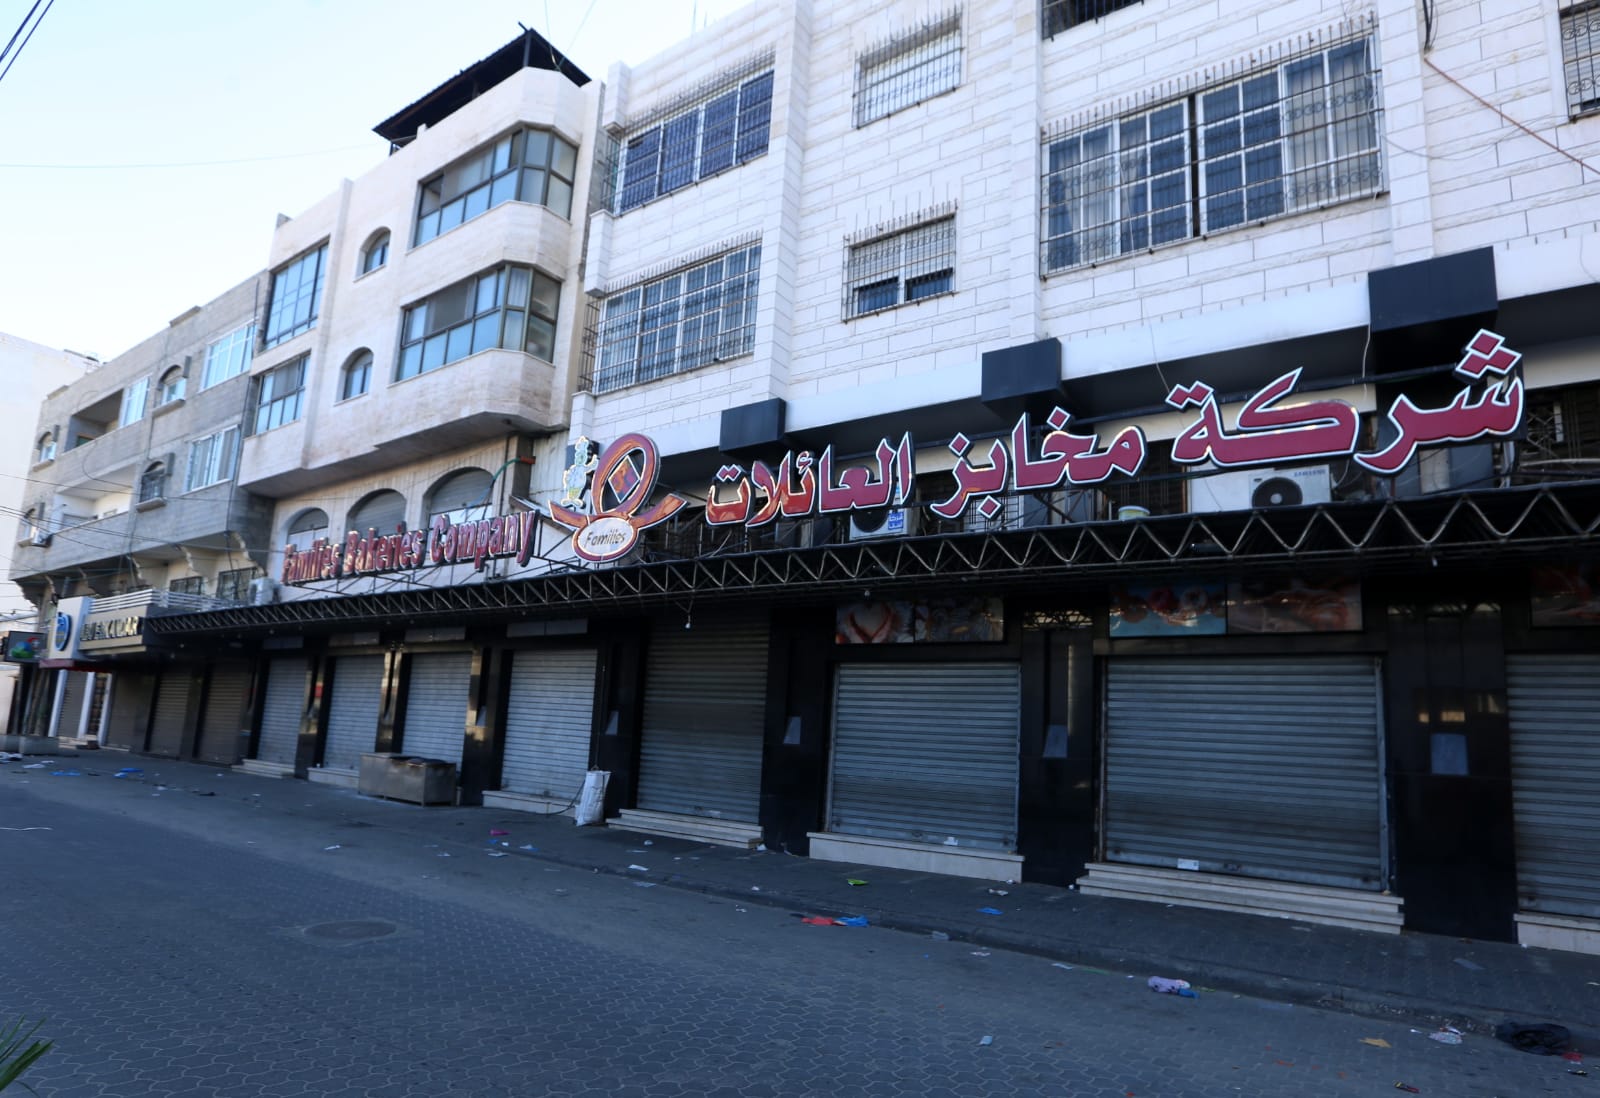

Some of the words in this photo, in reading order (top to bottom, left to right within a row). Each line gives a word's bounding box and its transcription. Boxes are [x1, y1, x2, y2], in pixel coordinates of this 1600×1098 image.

[1165, 328, 1524, 473] شركة
[705, 430, 914, 528] العائلات
[930, 405, 1146, 519] مخابز
[281, 536, 341, 585] Families
[343, 521, 428, 576] Bakeries
[430, 511, 537, 571] Company
[584, 528, 626, 548] Families
